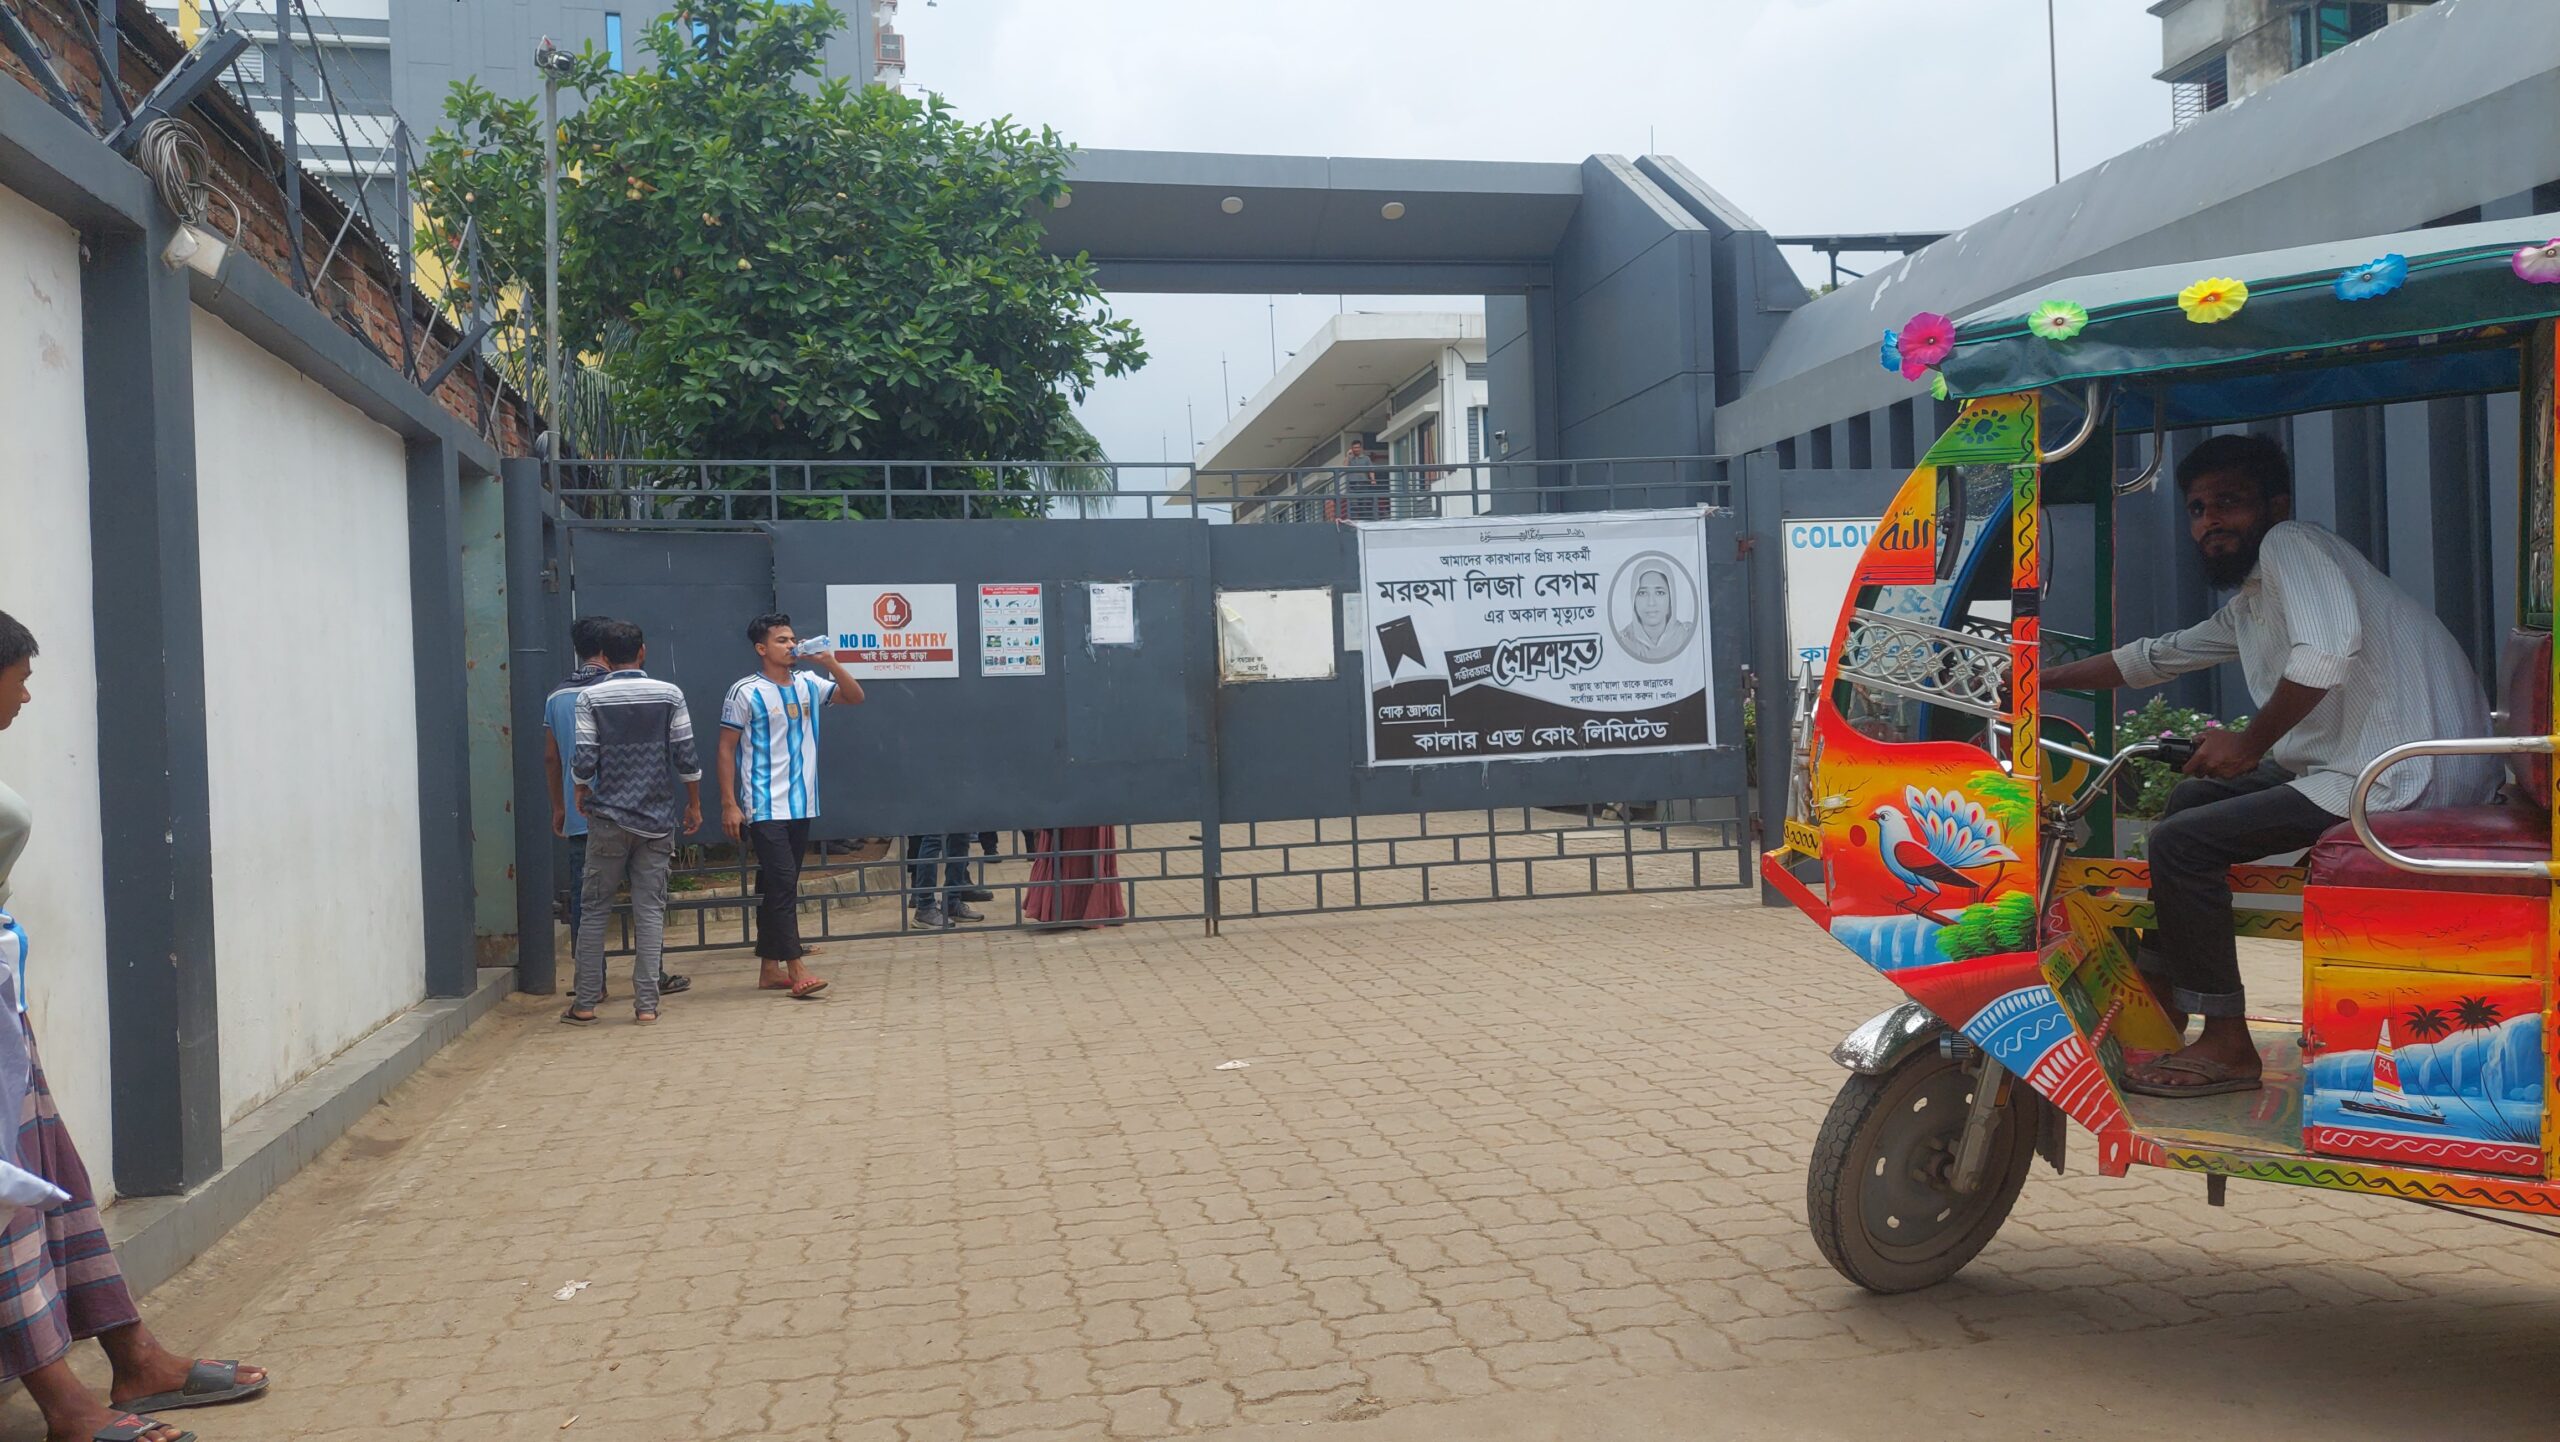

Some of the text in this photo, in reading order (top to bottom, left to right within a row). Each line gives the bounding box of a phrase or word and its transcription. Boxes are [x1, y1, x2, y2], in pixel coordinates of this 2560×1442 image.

[1440, 546, 1591, 567] আমাদের কারখানার প্রিয় সহকর্মী
[1376, 569, 1600, 607] মরহুমা লিজা বেগম
[883, 614, 901, 622] STOP
[1484, 606, 1597, 627] এর অকাল মৃত্যুতে
[839, 632, 947, 648] NO ID, NO ENTRY
[860, 650, 928, 662] আই ডি কার্ড ছাড়া
[1453, 649, 1482, 664] আমরা
[1496, 638, 1599, 681] শোকাহত
[1454, 664, 1492, 681] গভীরভাবে
[1622, 680, 1640, 689] তাকে
[1643, 678, 1674, 689] জান্নাতের
[1596, 693, 1618, 703] মাকাম
[1378, 703, 1441, 719] শোক জ্ঞাপনে
[1412, 717, 1669, 752] কালার এন্ড কোং লিমিটেড
